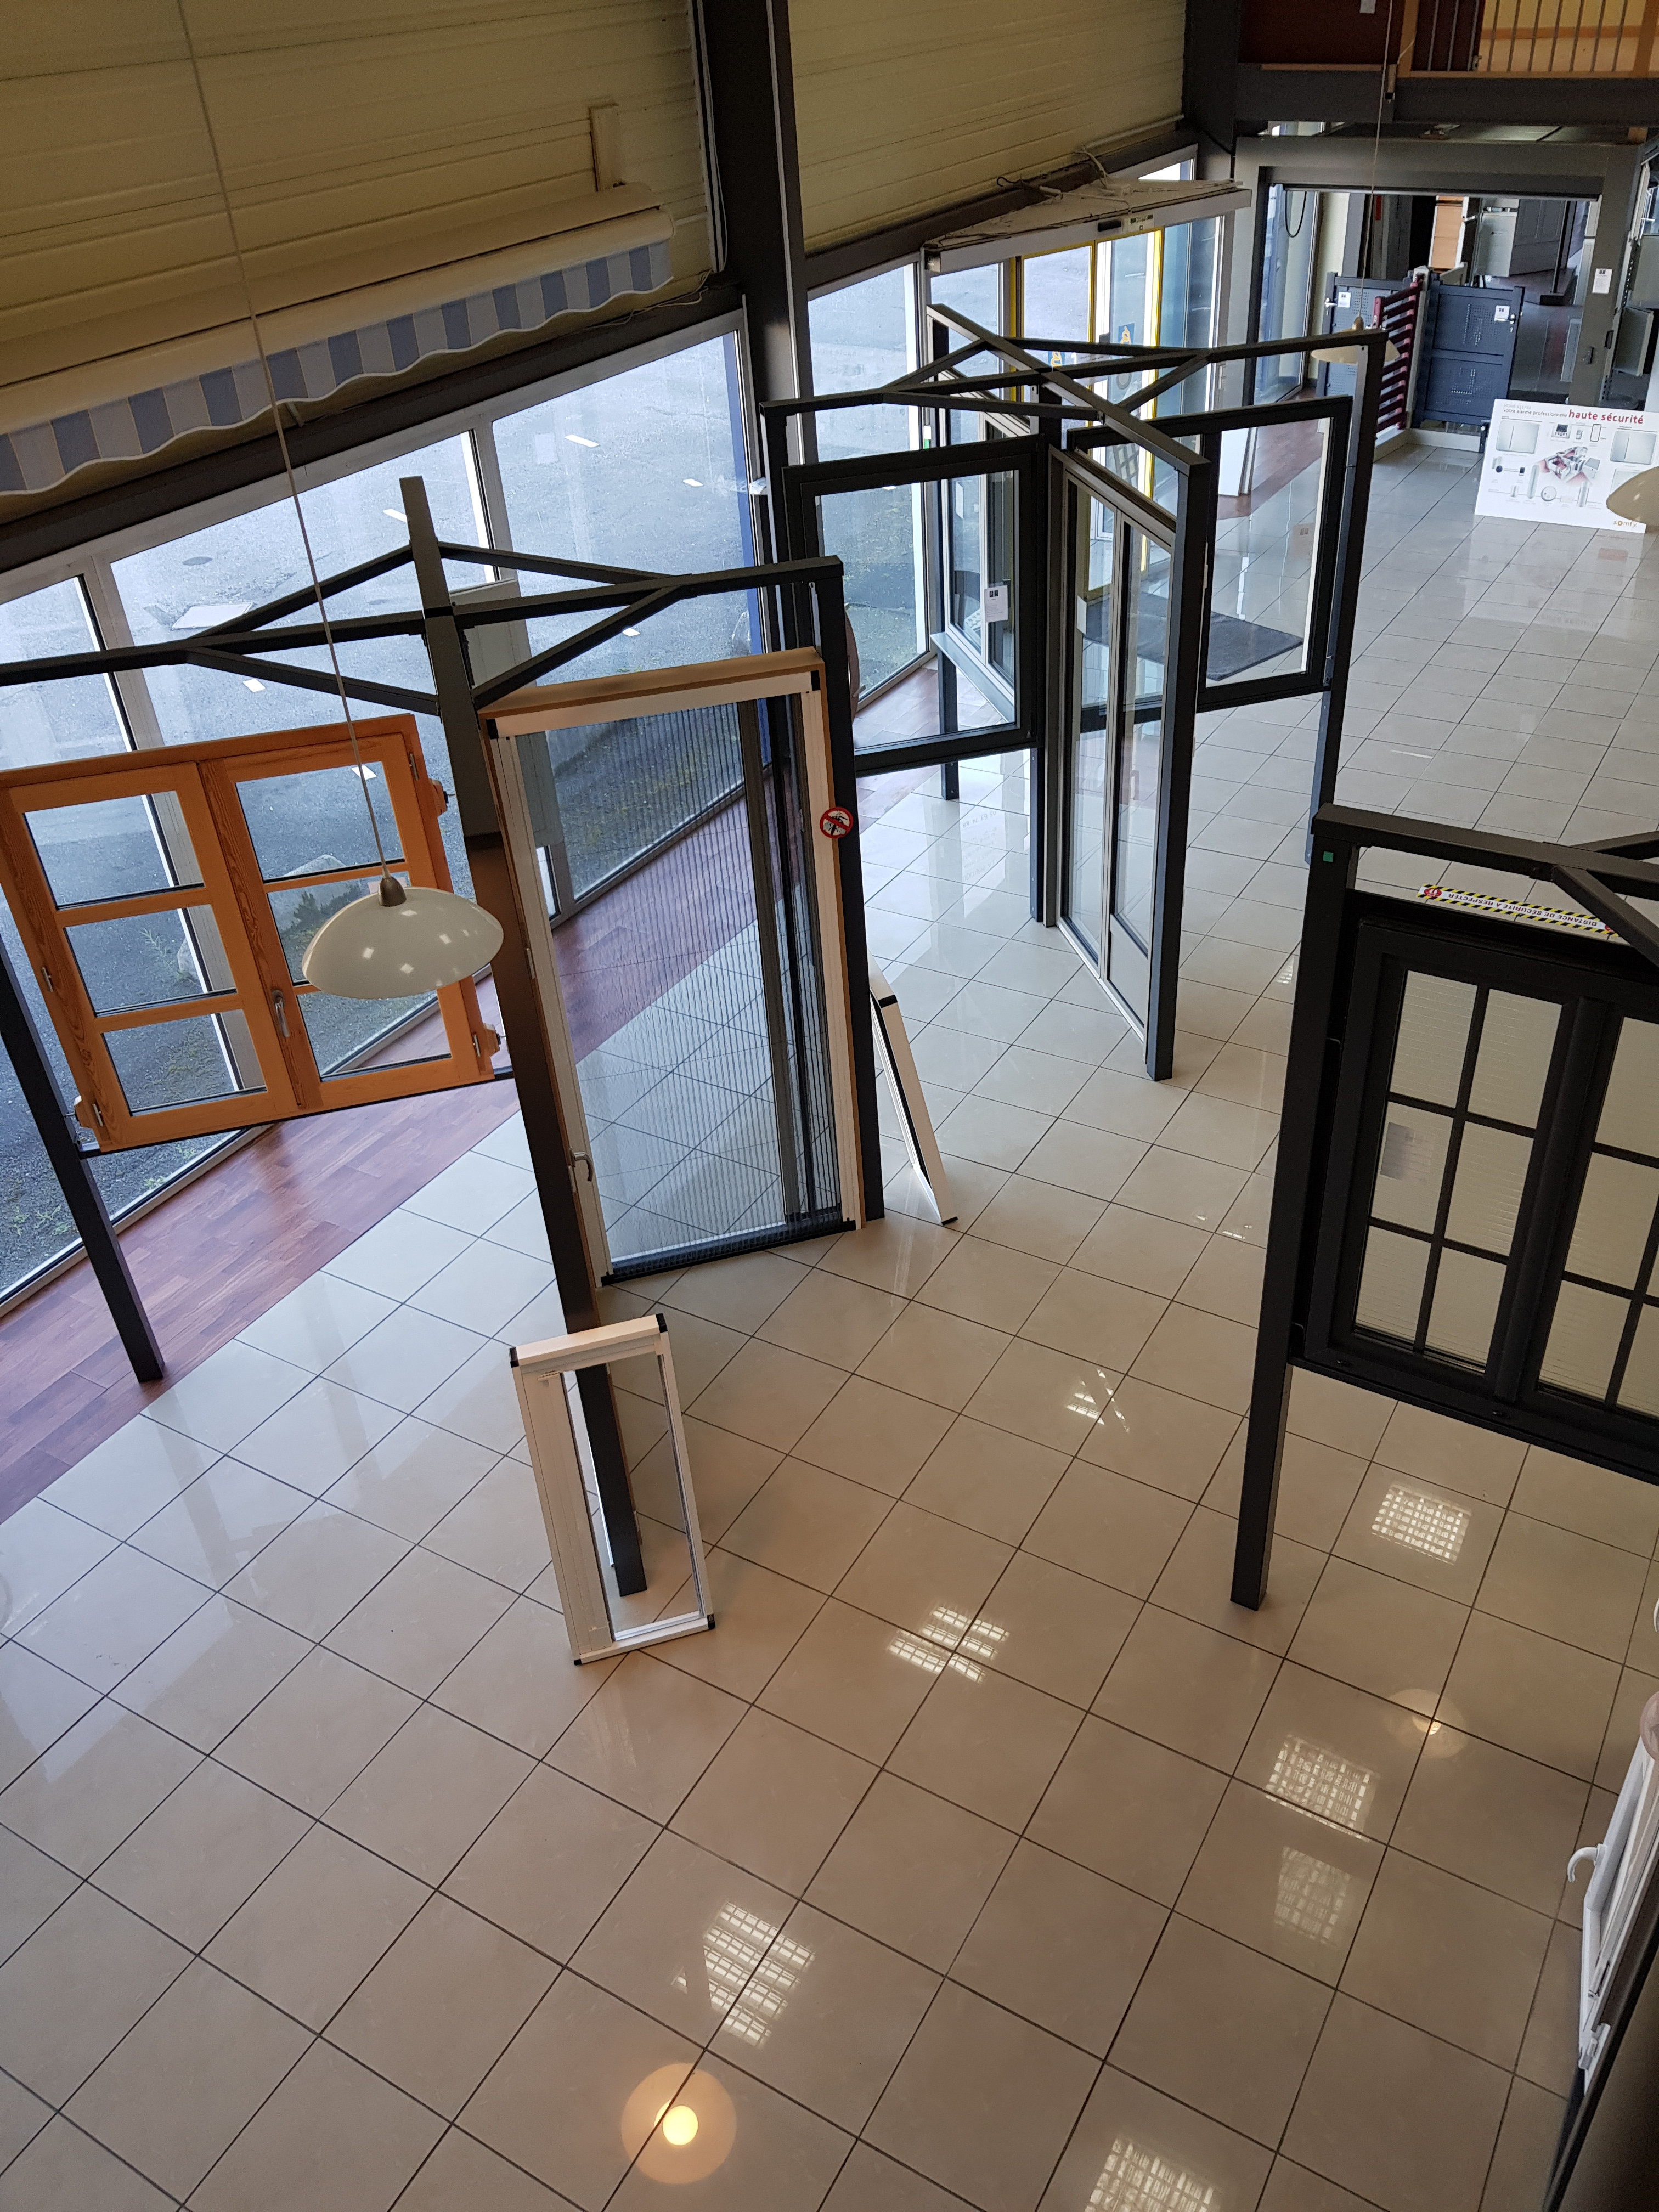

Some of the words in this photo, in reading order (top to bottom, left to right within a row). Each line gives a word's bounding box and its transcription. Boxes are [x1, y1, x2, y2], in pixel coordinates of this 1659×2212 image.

[1568, 409, 1598, 420] haute
[1601, 413, 1644, 424] sécurité
[1448, 893, 1492, 906] RESPECTER
[1503, 904, 1543, 917] SÉCURITÉ
[1557, 915, 1598, 927] DISTANCE
